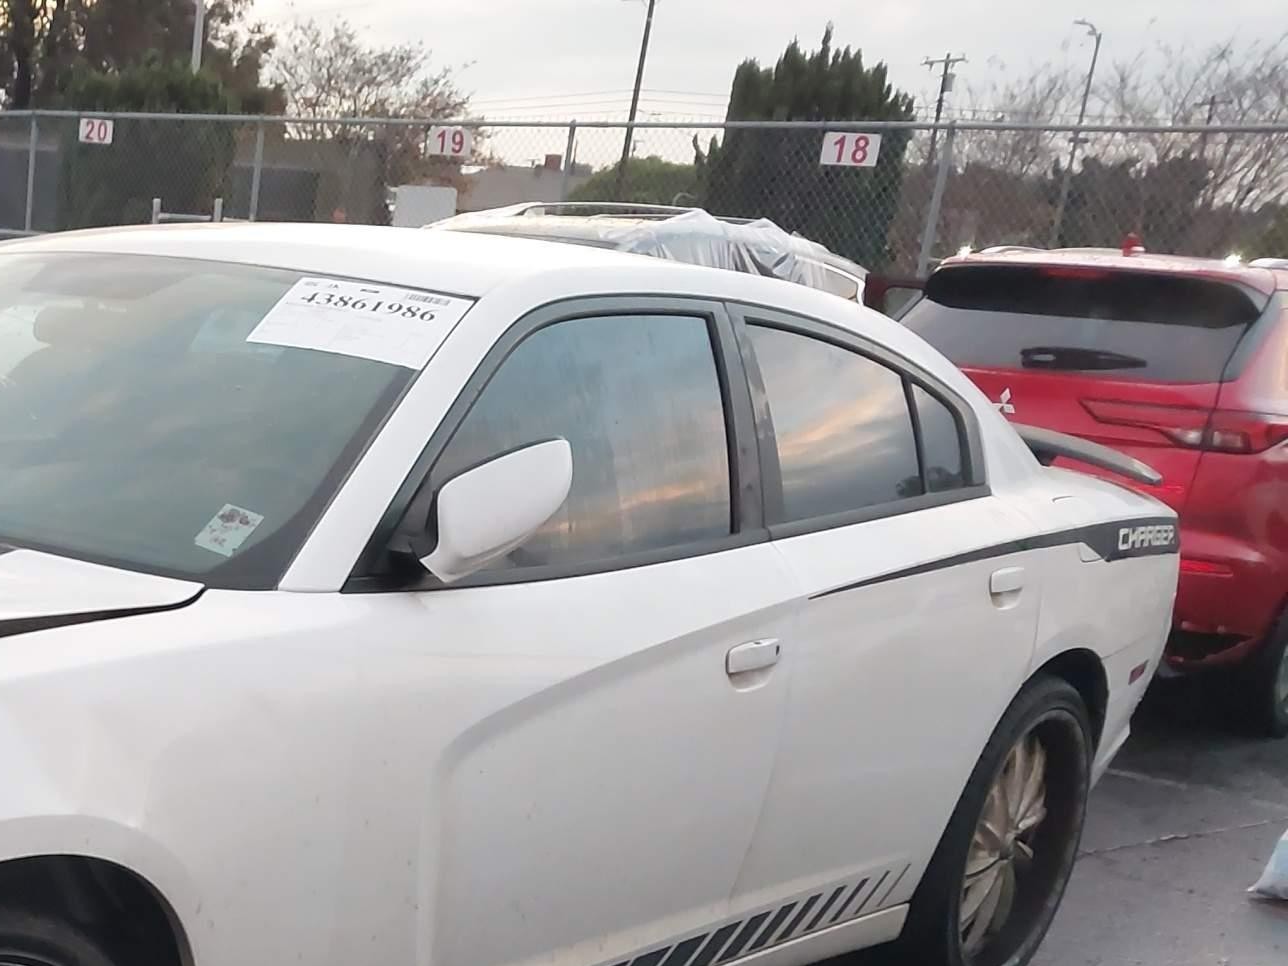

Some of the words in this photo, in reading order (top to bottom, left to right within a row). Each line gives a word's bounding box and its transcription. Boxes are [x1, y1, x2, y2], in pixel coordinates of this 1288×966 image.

[85, 120, 109, 141] 20
[435, 130, 465, 154] 19
[833, 135, 870, 164] 18
[300, 291, 440, 322] 43861986
